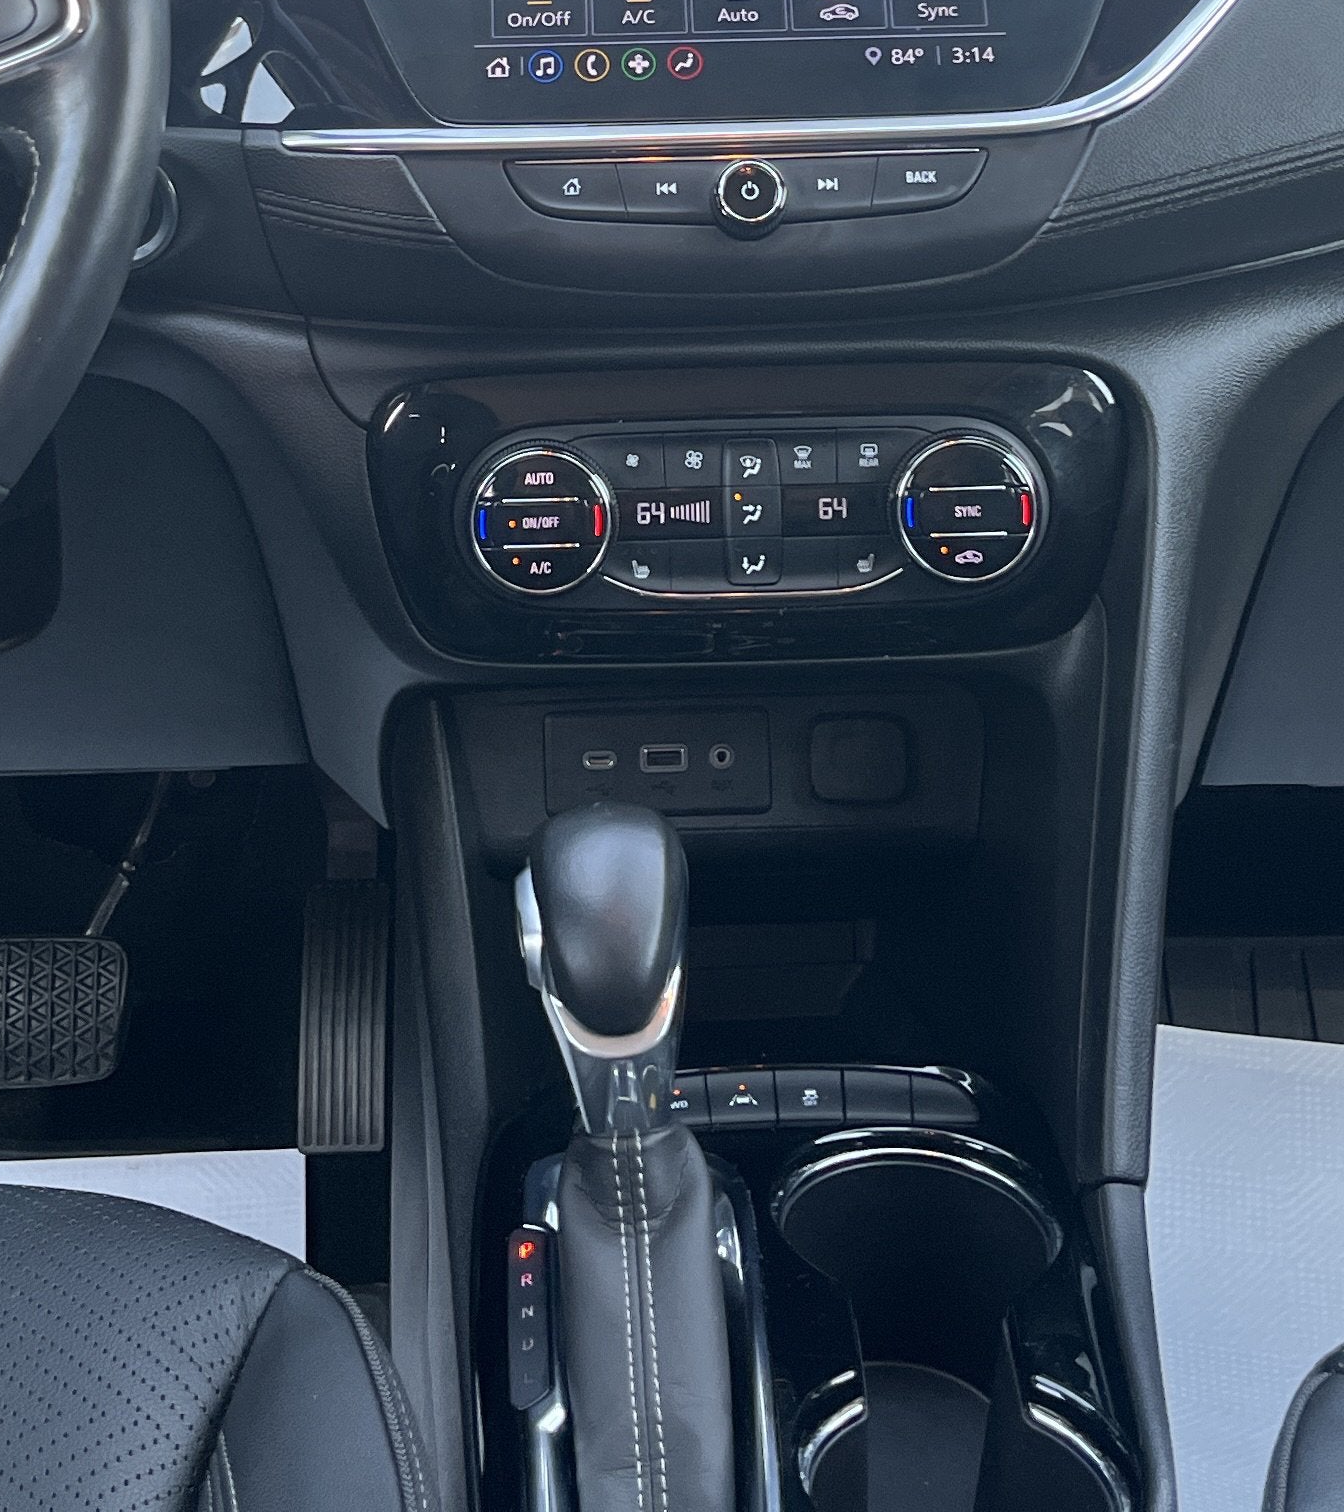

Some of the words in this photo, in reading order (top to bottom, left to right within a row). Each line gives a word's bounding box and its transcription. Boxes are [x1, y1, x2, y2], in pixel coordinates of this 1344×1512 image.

[507, 10, 572, 29] On/Off
[621, 7, 655, 26] A/C
[717, 6, 759, 24] Auto
[916, 1, 959, 21] Sync
[950, 45, 996, 65] 3:14
[905, 170, 937, 185] BACK
[524, 472, 554, 486] AUTO
[636, 502, 666, 525] 64
[818, 497, 848, 520] 64
[954, 504, 982, 518] SYNC
[522, 516, 561, 530] ON/OFF
[529, 561, 552, 575] A/C
[518, 1241, 536, 1260] P
[520, 1272, 534, 1288] R
[521, 1304, 534, 1319] N
